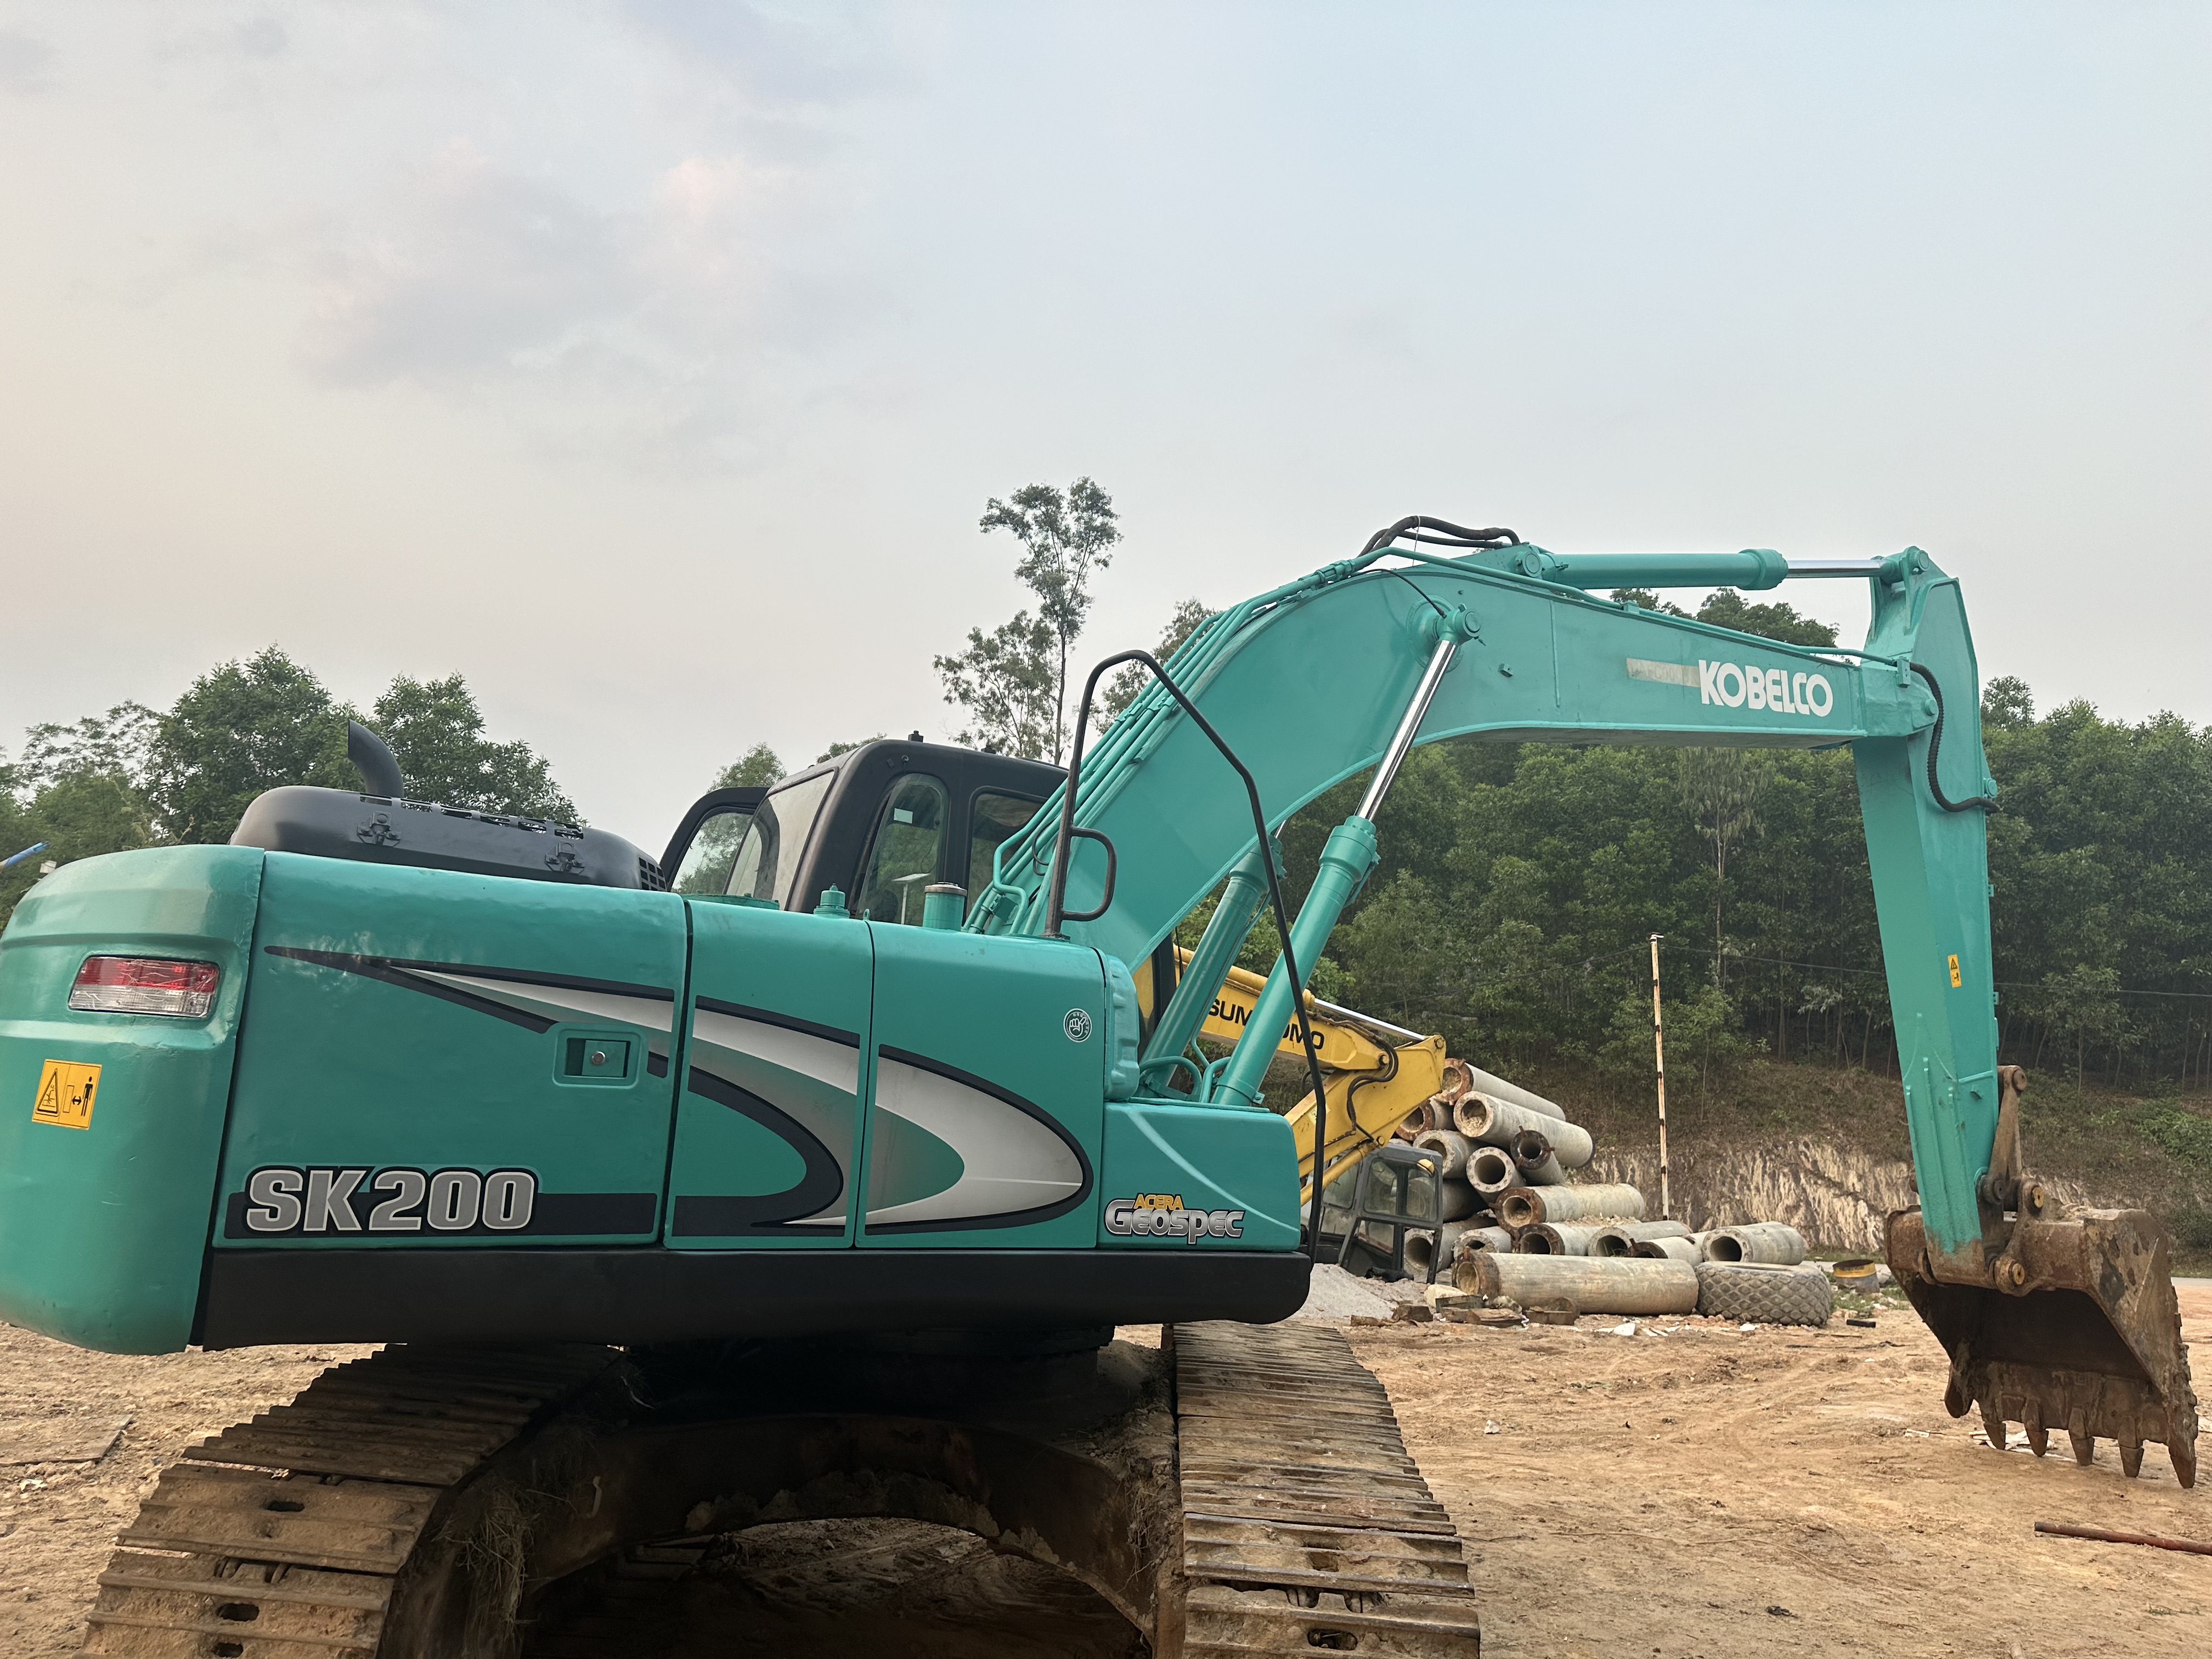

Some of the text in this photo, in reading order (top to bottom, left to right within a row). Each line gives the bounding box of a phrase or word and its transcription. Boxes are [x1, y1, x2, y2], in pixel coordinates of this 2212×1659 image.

[1699, 659, 1833, 717] KOBELCO
[1209, 998, 1325, 1049] SUMMO
[246, 1169, 535, 1231] SK200
[1133, 1194, 1184, 1210] ACERA
